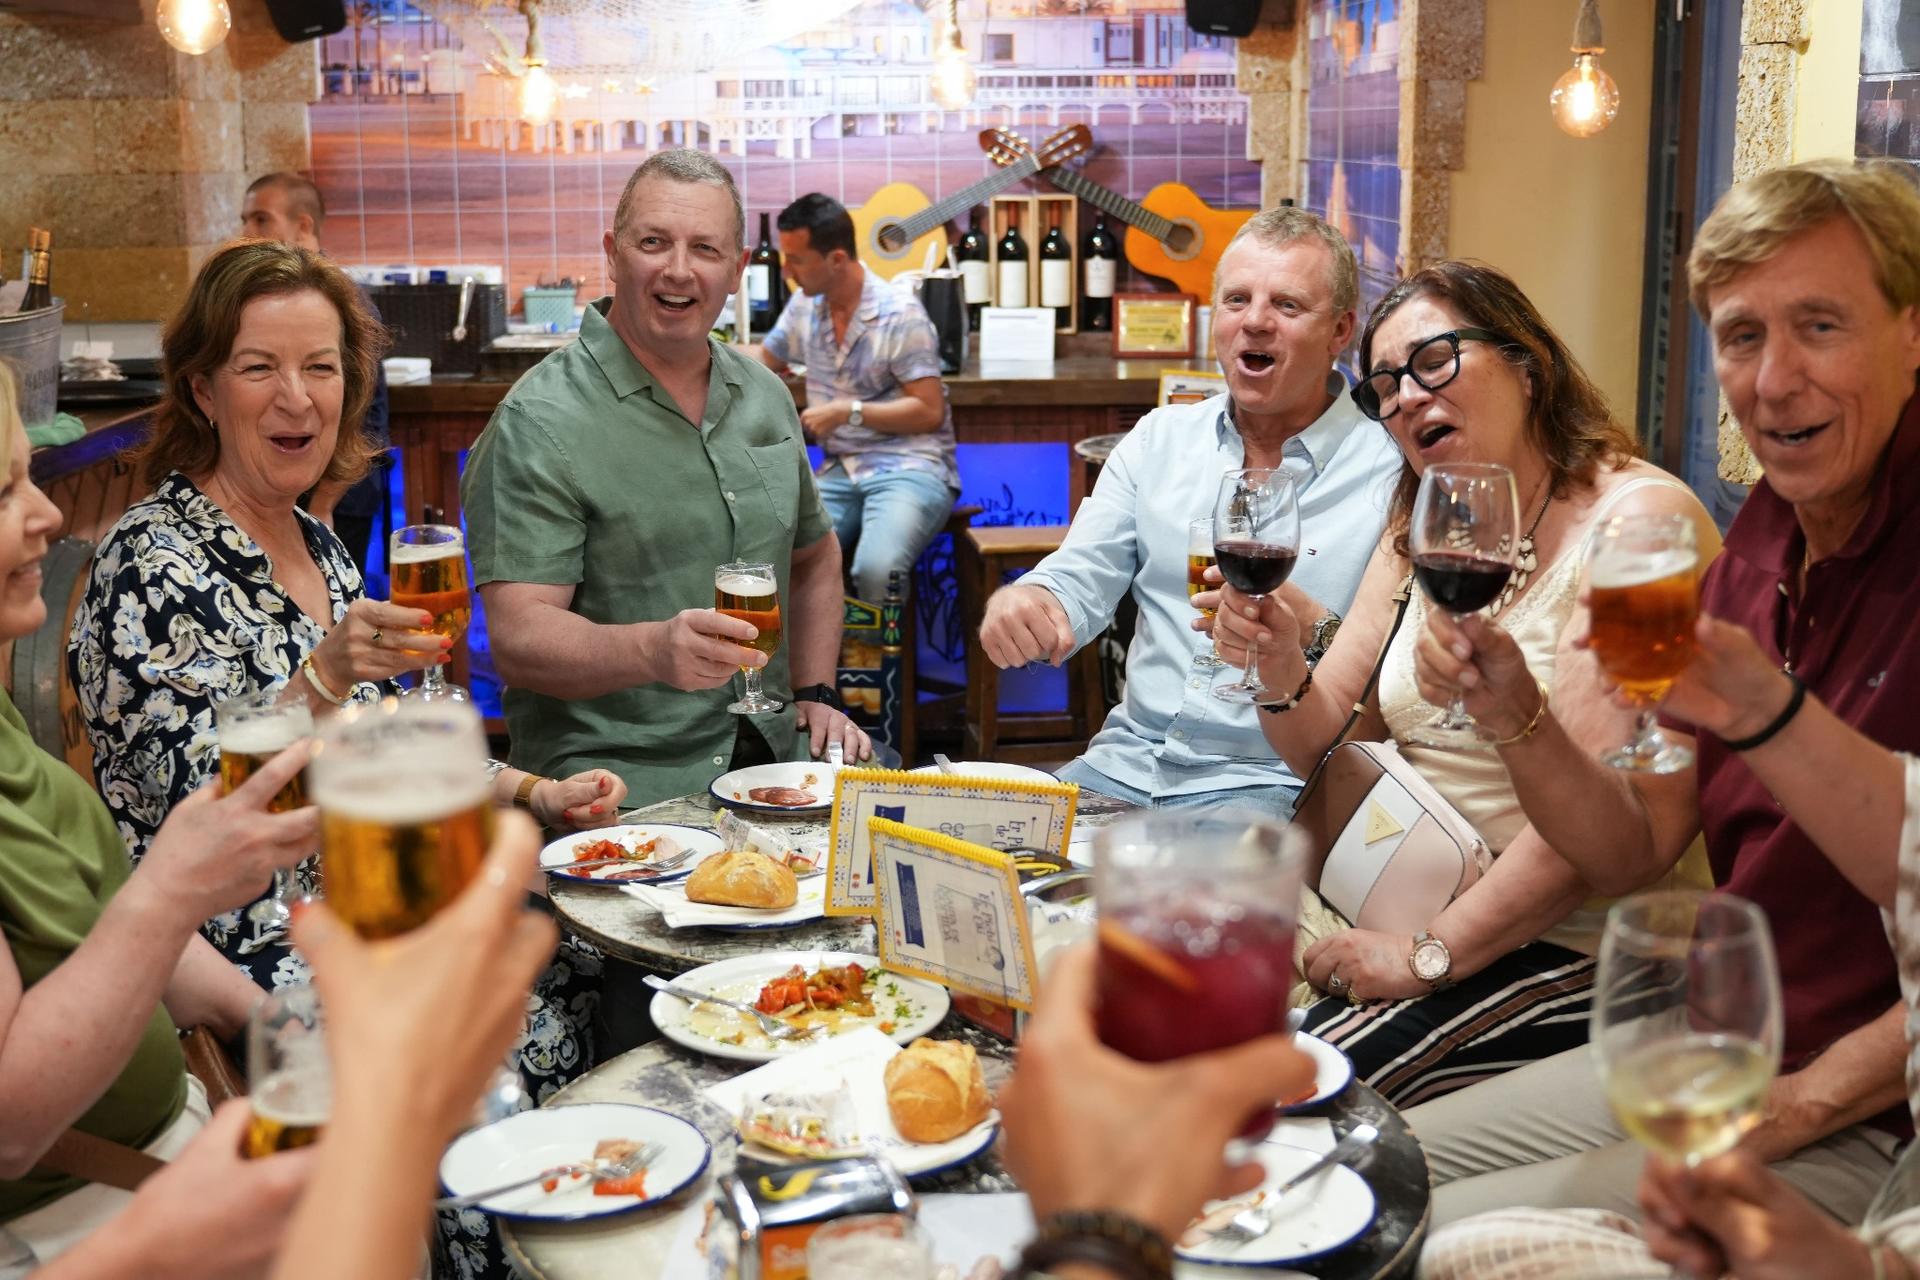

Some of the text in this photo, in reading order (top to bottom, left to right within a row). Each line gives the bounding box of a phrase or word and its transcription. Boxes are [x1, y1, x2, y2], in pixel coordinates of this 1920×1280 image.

[995, 825, 1009, 838] de
[1008, 821, 1025, 848] Er Pi
